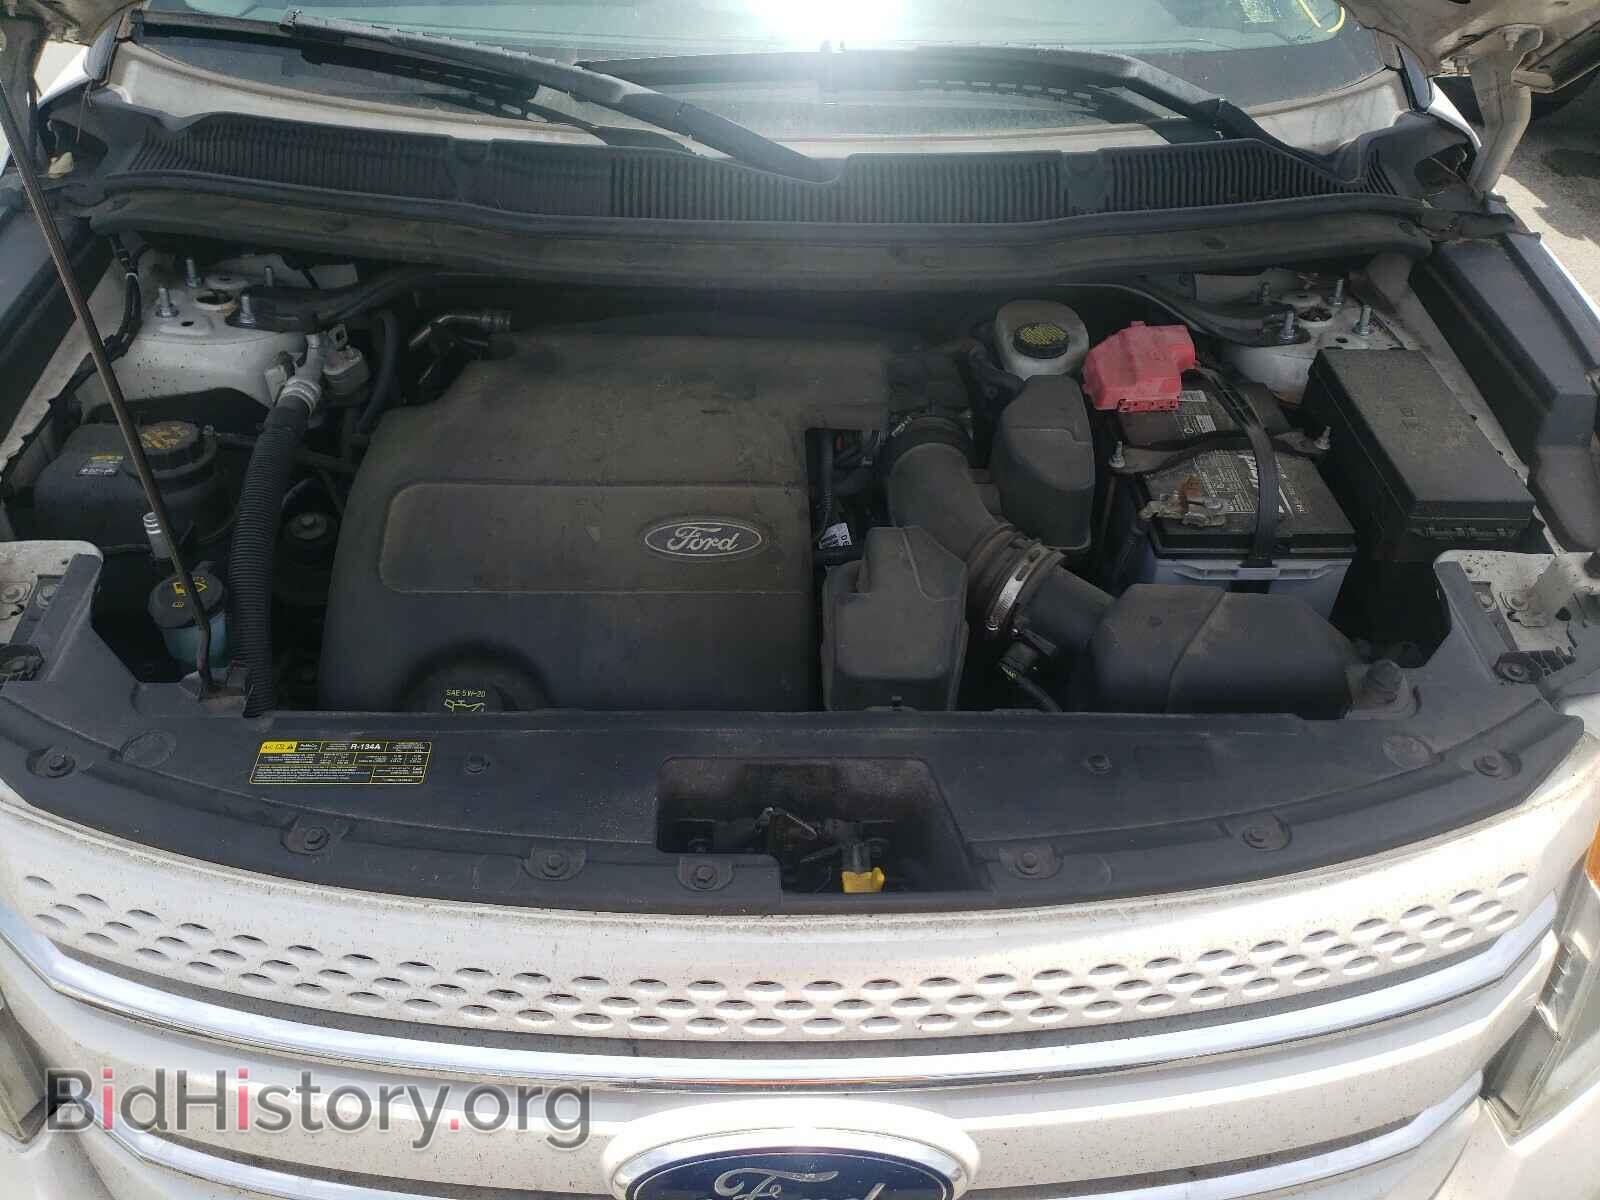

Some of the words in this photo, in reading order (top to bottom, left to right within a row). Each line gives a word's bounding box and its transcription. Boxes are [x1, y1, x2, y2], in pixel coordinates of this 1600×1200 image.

[667, 526, 740, 551] Ford
[446, 689, 461, 697] SAE
[462, 690, 486, 698] 5W-20
